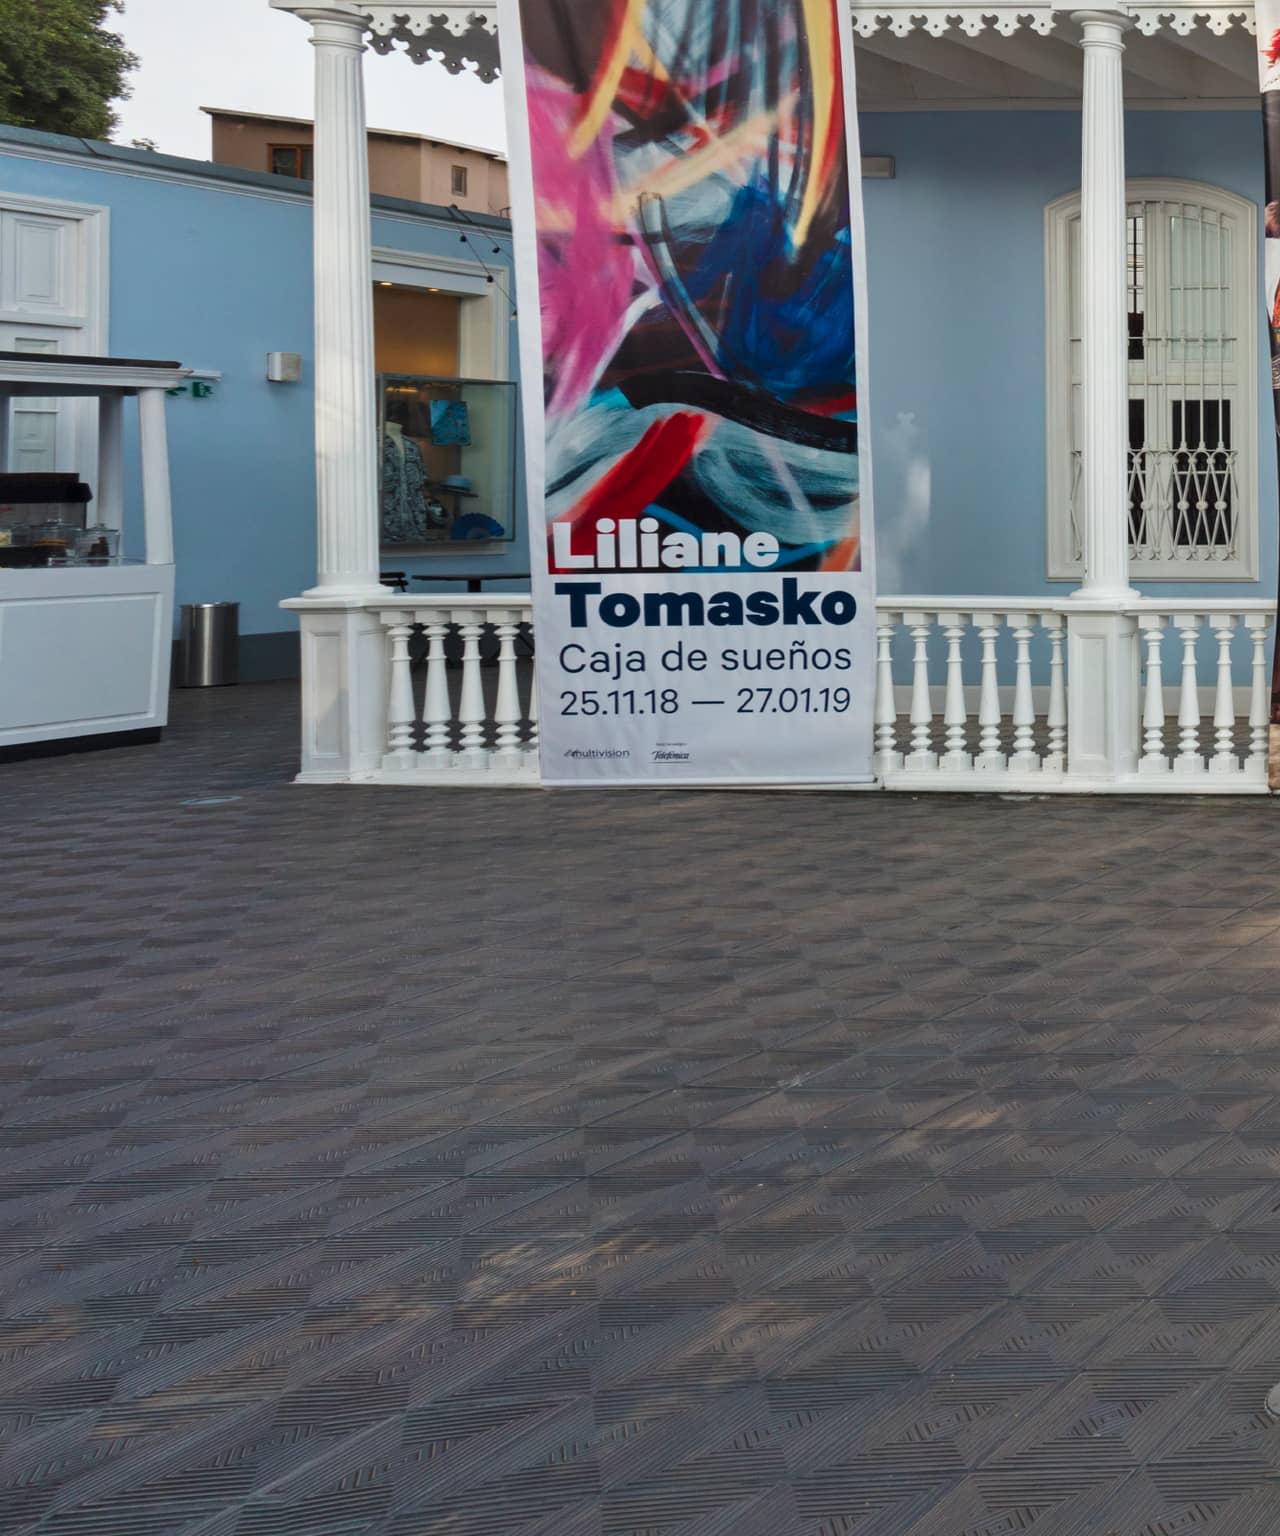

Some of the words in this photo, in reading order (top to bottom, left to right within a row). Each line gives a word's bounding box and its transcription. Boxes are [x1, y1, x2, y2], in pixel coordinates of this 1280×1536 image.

[552, 517, 780, 569] Liliane
[554, 577, 857, 628] Tomasko
[559, 643, 646, 681] Caja
[661, 641, 708, 671] de
[721, 640, 852, 671] sueños
[560, 688, 679, 716] 25.11.18
[737, 687, 850, 713] 27.01.19
[571, 749, 630, 759] multivision
